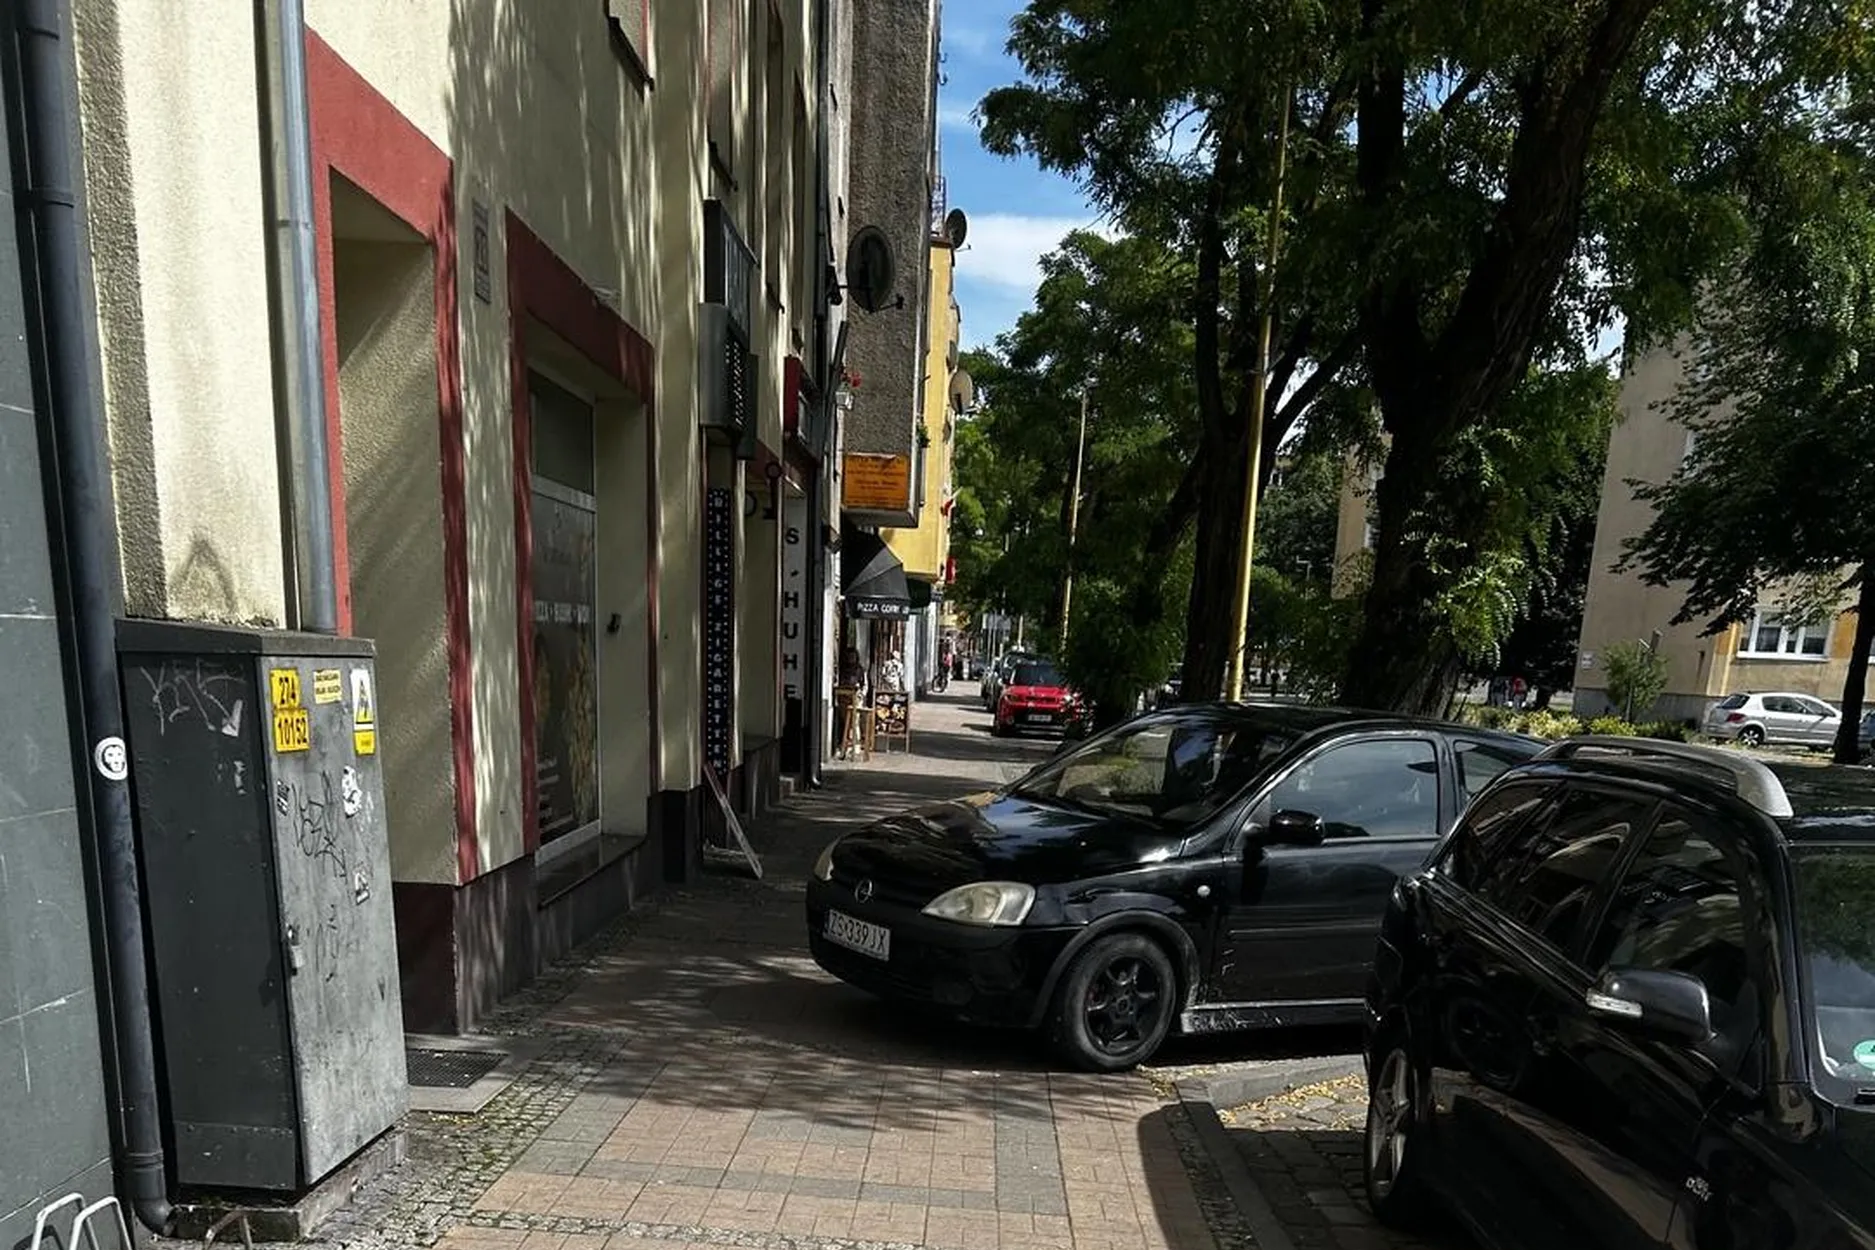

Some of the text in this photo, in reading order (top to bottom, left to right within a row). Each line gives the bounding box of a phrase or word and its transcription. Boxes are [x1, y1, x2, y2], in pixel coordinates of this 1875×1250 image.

[857, 602, 879, 613] PIZZA
[279, 677, 297, 705] 274
[277, 717, 307, 746] 10152
